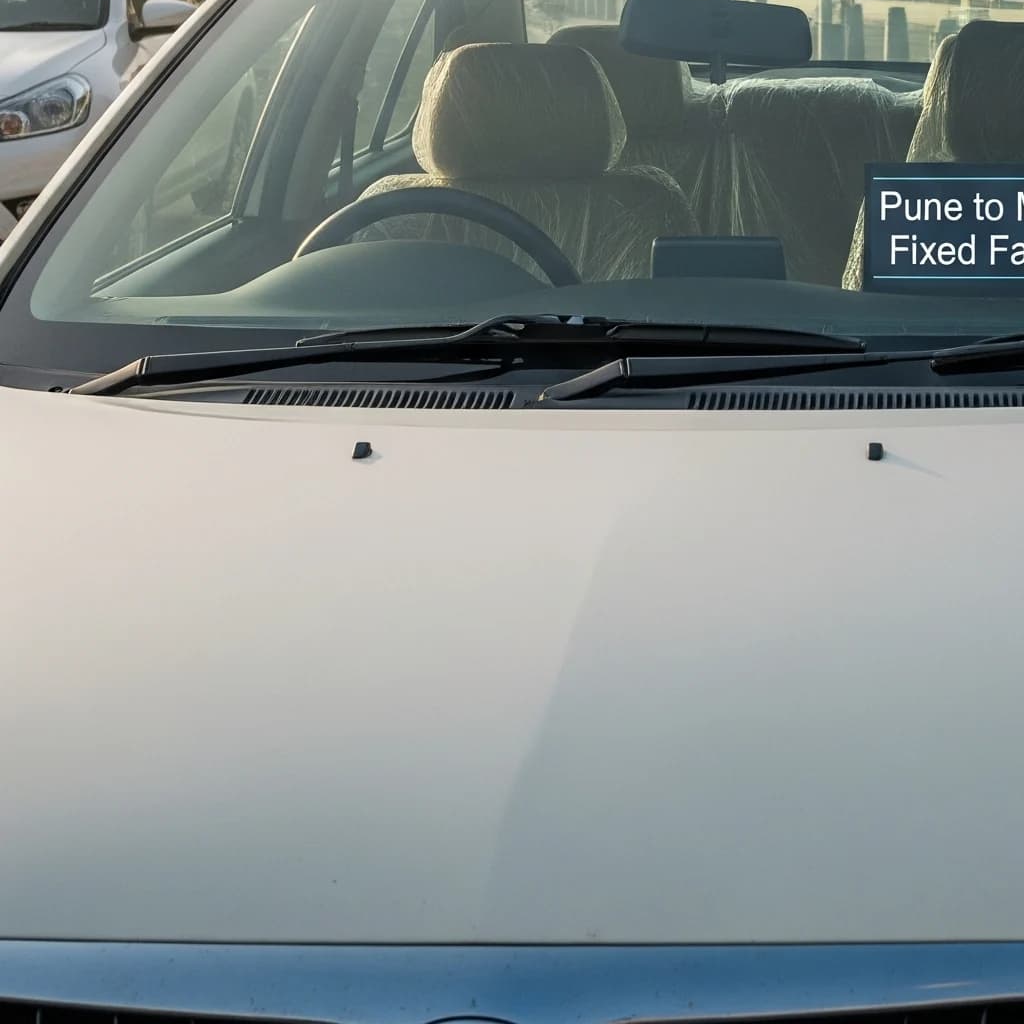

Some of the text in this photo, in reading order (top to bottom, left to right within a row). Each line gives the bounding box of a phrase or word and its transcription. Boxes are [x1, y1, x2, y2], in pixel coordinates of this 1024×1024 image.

[879, 190, 963, 222] Pune
[974, 191, 1005, 222] to
[889, 234, 976, 266] Fixed
